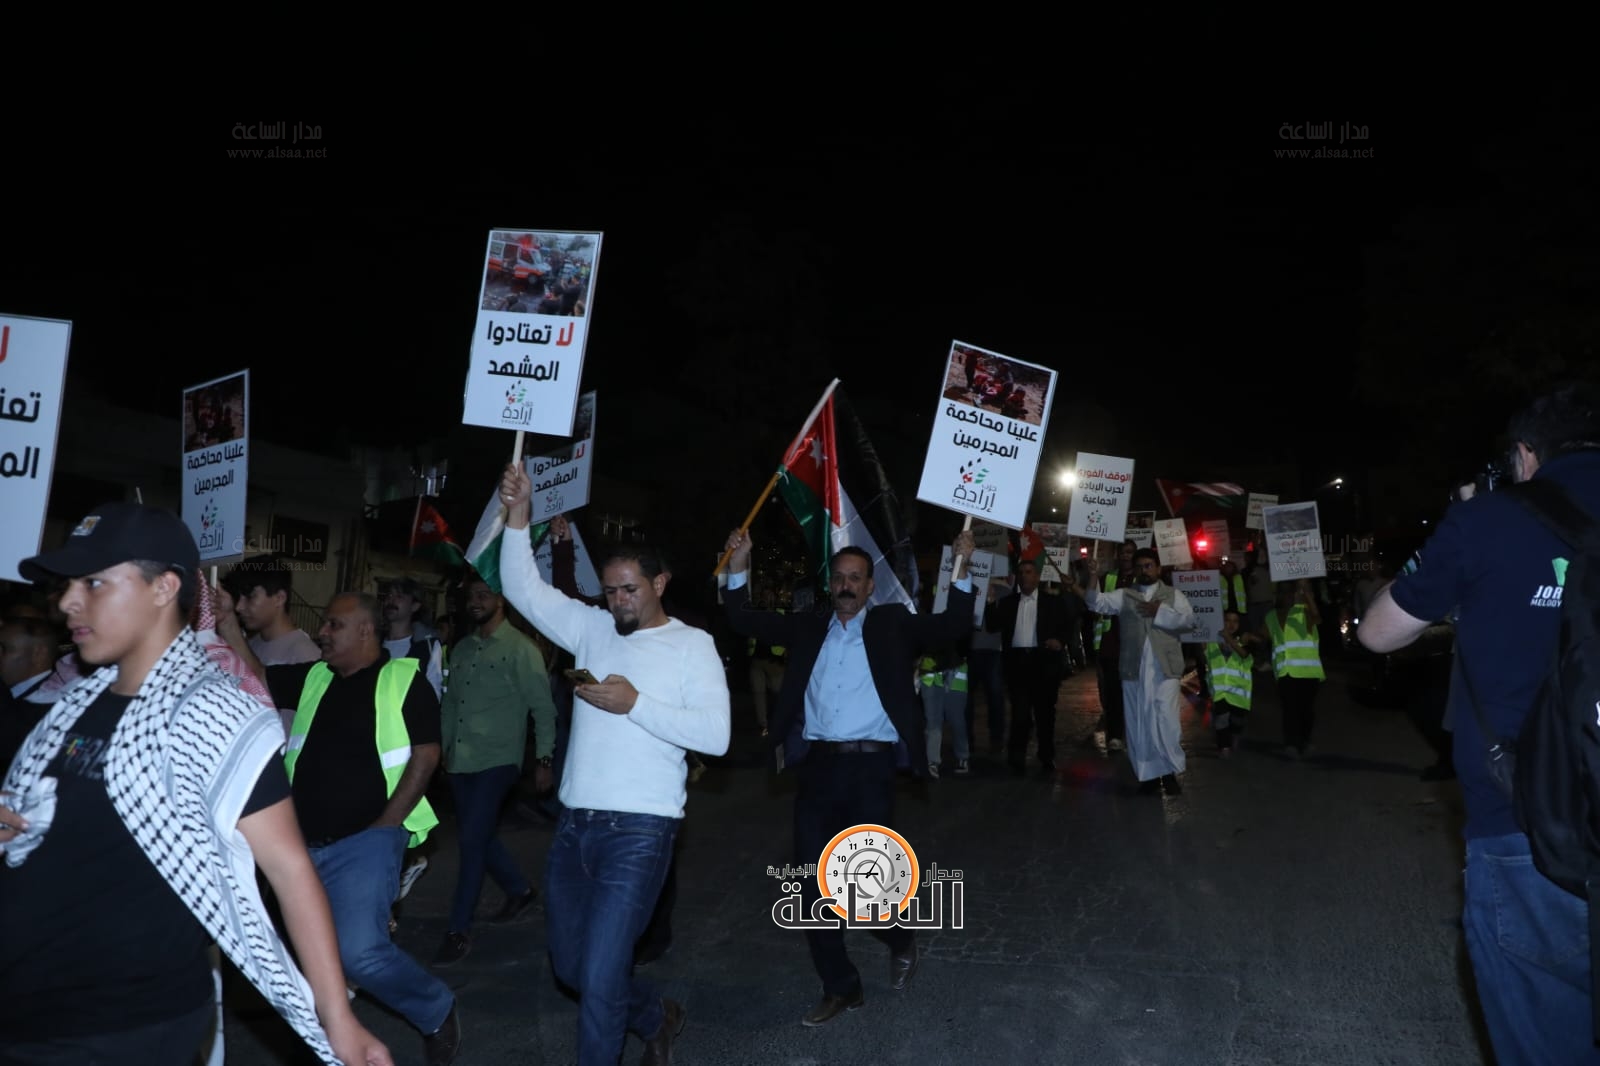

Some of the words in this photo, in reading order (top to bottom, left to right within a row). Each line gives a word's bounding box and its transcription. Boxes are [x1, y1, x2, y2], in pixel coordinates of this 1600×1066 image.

[488, 320, 552, 346] تعتادوا
[555, 322, 574, 346] لا
[487, 355, 560, 381] المشهد
[946, 403, 1004, 432] محاكمة
[1007, 421, 1038, 442] علينا
[224, 443, 244, 463] علينا
[953, 429, 1019, 459] المجرمين
[187, 450, 222, 470] محاكمة
[194, 469, 234, 495] المجرمين
[534, 467, 578, 493] المشهد
[953, 484, 996, 512] إرادة
[1195, 575, 1211, 583] the
[1182, 589, 1220, 598] ENOCIDE
[1530, 599, 1563, 608] MELODY
[1533, 585, 1564, 600] JOR
[1193, 605, 1214, 613] Gaza
